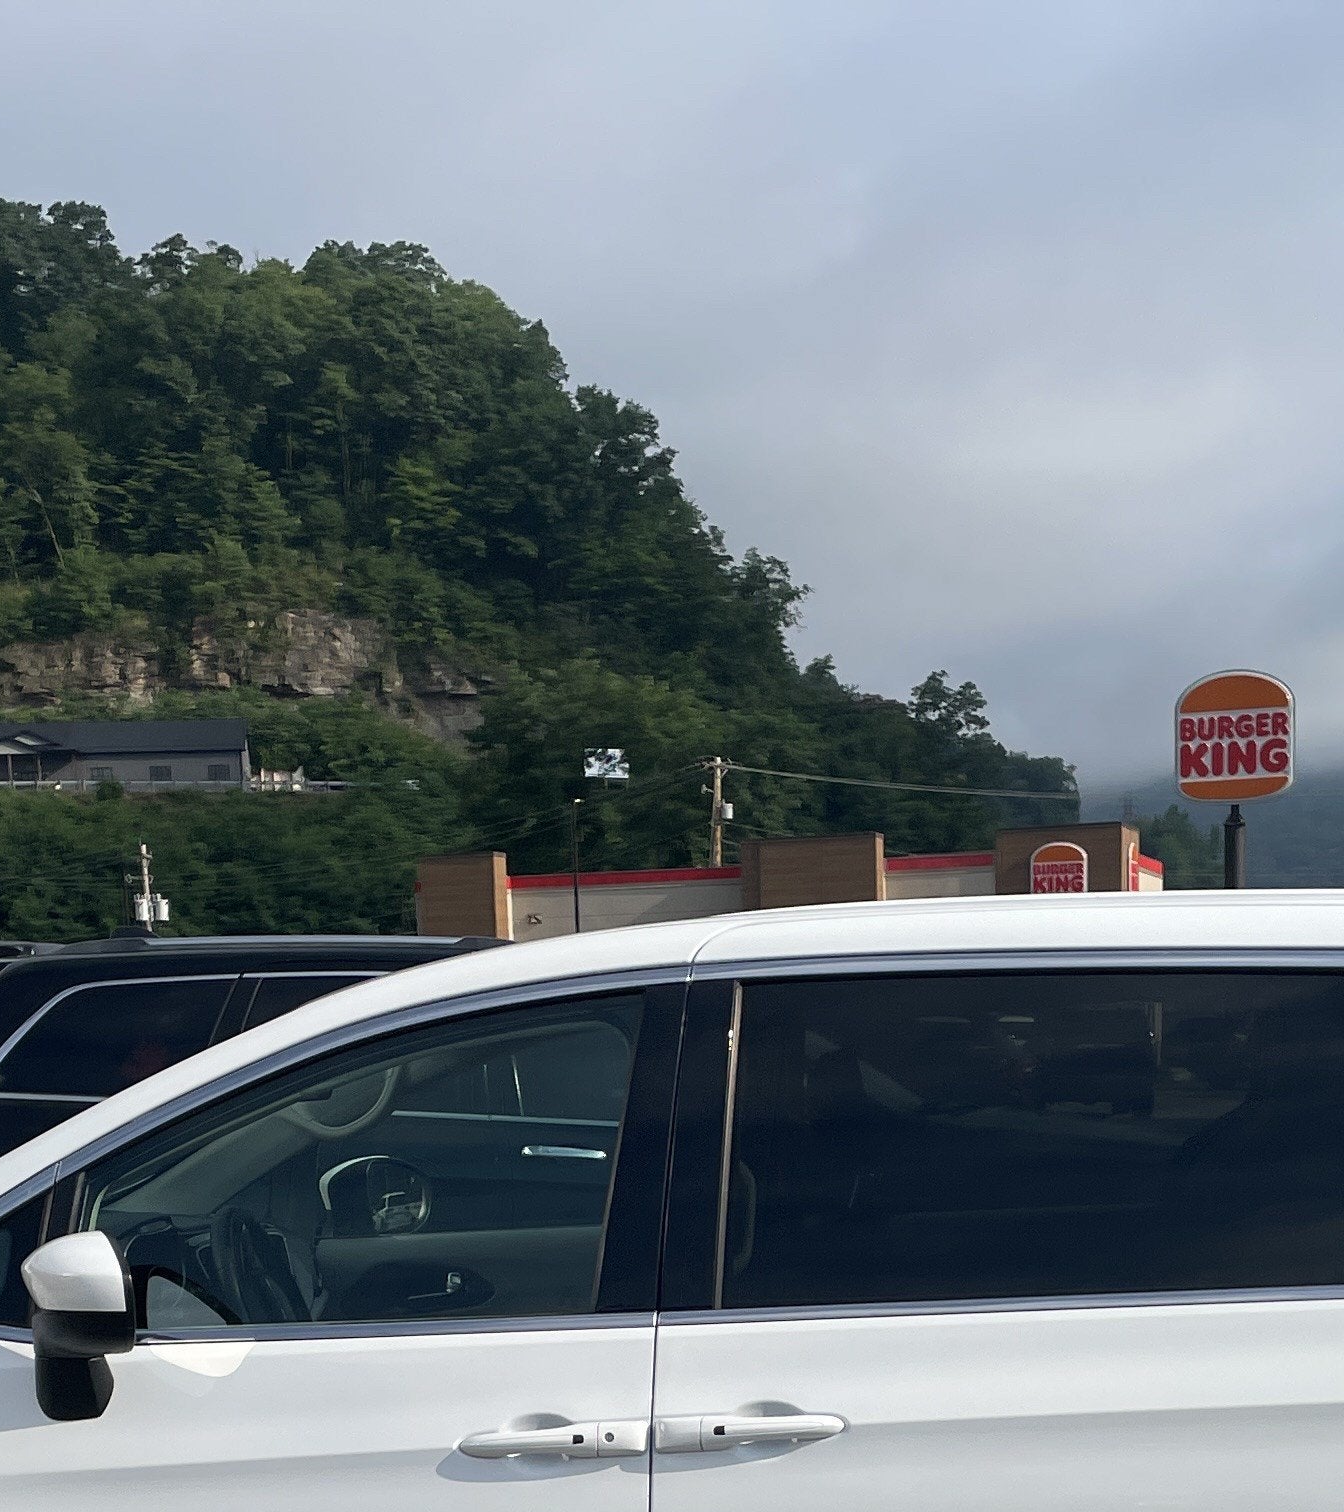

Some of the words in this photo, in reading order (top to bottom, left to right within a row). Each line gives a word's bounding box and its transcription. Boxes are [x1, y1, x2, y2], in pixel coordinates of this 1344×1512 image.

[1179, 712, 1289, 742] BURGER
[1179, 738, 1289, 778] KING
[1033, 875, 1084, 893] KING
